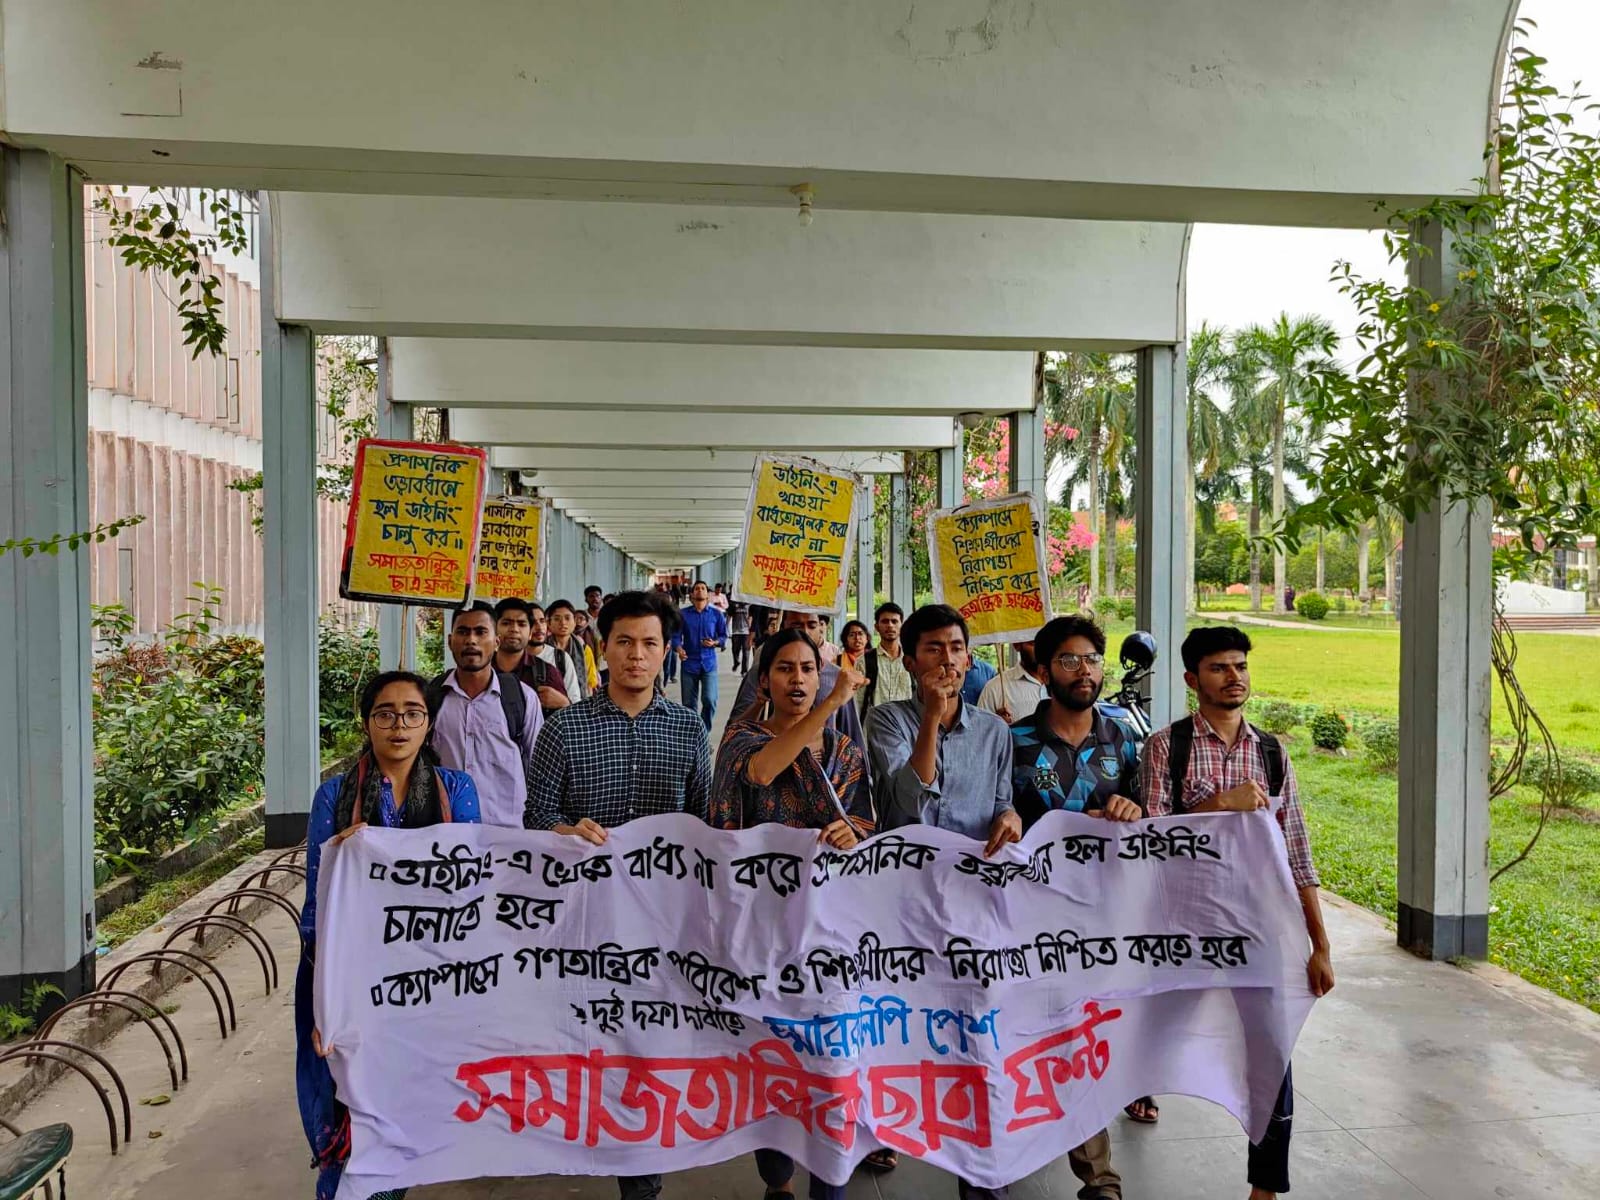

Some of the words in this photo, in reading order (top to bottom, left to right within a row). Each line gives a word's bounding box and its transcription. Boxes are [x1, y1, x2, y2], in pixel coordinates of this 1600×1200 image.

[383, 453, 469, 474] প্রশাসনিক
[772, 465, 825, 495] ডাইনিং
[369, 499, 399, 520] হল
[405, 496, 462, 525] ডাইনিং
[779, 491, 830, 512] খাওয়া
[955, 509, 1016, 533] ক্যাম্পাসে
[382, 523, 420, 554] চালু
[809, 538, 829, 552] না
[959, 553, 1017, 576] নিরাপত্তা
[960, 576, 1008, 597] নিশ্চিত
[1010, 571, 1038, 590] কর
[623, 835, 688, 883] বাধ্য
[730, 852, 803, 898] করে
[1062, 834, 1112, 864] হল
[1117, 823, 1222, 861] ডাইনিং
[383, 896, 484, 945] চালাতে
[495, 892, 564, 931] হবে
[382, 952, 504, 1007] ক্যাম্পাসে
[513, 942, 660, 985] গণতান্ত্রিক
[778, 963, 805, 994] ও
[1034, 929, 1118, 973] নিশ্চিত
[1123, 933, 1192, 967] করতে
[1198, 936, 1251, 969] হবে
[588, 988, 625, 1033] দুই
[632, 1000, 679, 1030] দফা
[920, 1006, 1001, 1055] পেশ
[867, 1059, 992, 1157] ছাত্র
[1003, 1001, 1122, 1133] ফ্রন্ট
